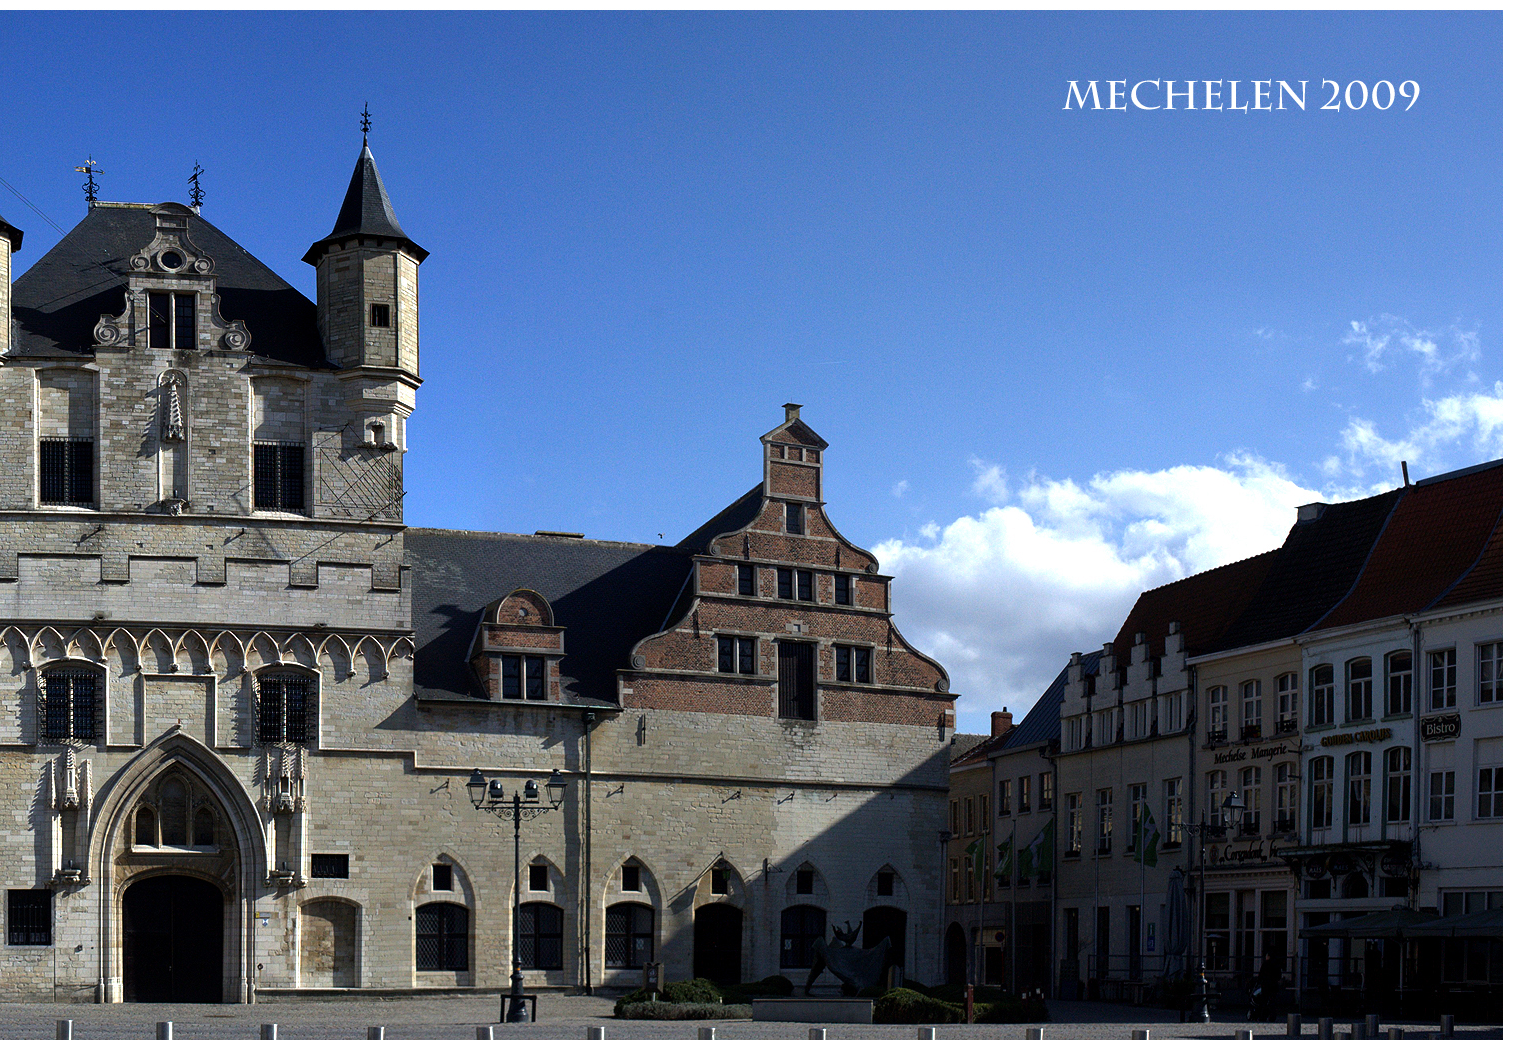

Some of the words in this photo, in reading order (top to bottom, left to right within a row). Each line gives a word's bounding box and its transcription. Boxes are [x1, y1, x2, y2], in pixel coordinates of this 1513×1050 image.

[1427, 722, 1456, 736] Bistro
[1320, 734, 1353, 747] GOUDEN
[1214, 748, 1246, 764] Mechelse
[1251, 743, 1287, 761] Mangerie
